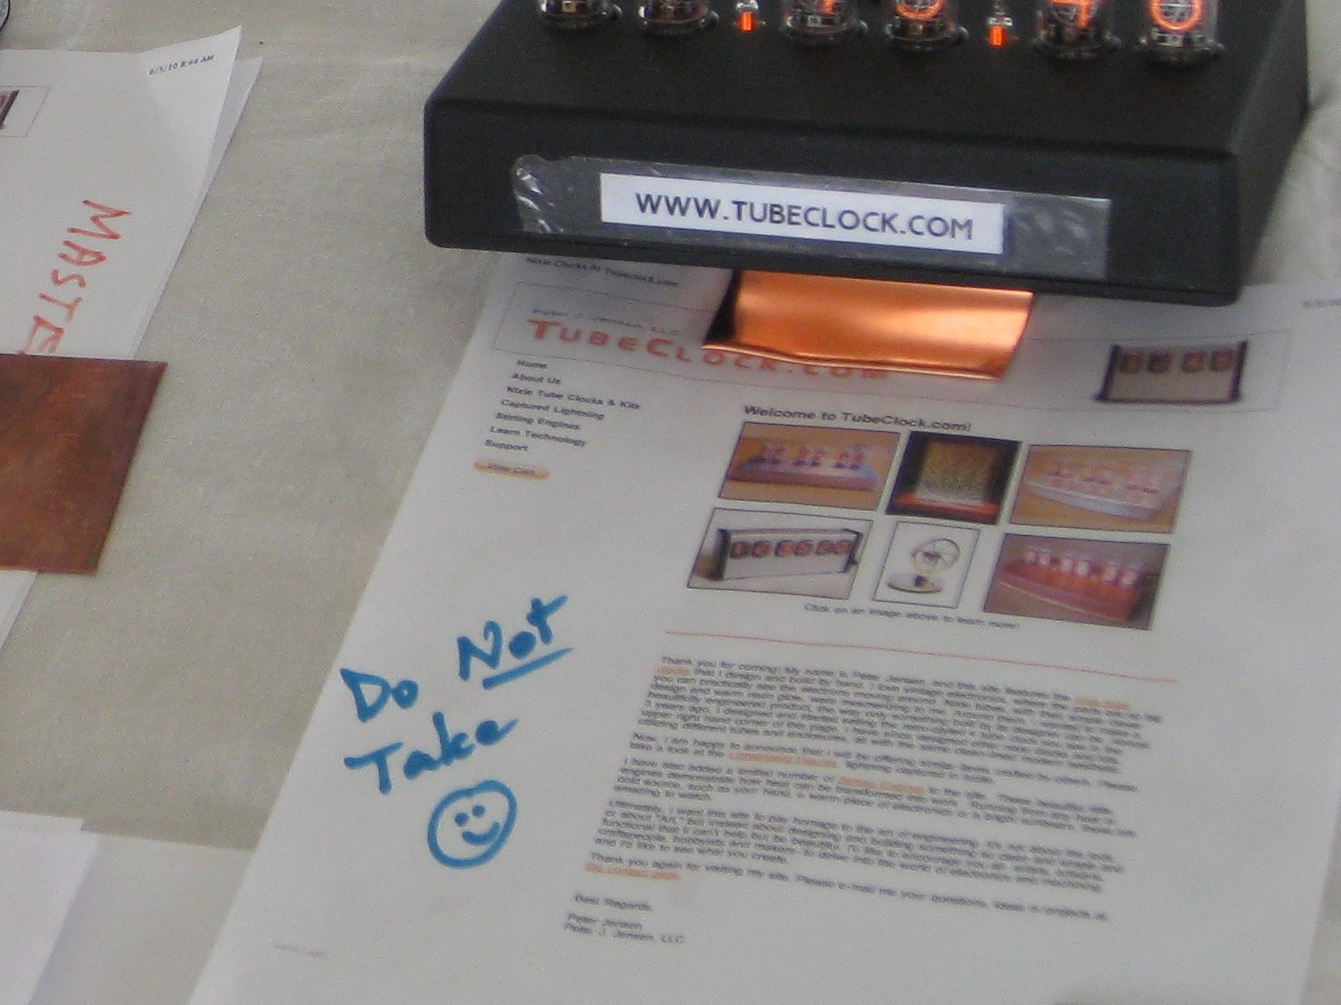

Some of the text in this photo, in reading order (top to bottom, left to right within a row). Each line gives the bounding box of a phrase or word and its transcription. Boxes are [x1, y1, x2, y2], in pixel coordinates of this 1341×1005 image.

[636, 193, 973, 241] WWW.TUBECLOCK.COM
[17, 199, 133, 355] MASTE
[517, 359, 548, 370] Home
[512, 373, 544, 384] About
[501, 399, 550, 412] Captured
[744, 404, 816, 421] Welcome
[821, 411, 837, 421] to
[484, 438, 529, 453] Support
[340, 594, 570, 723] Do Not
[344, 710, 520, 796] Take
